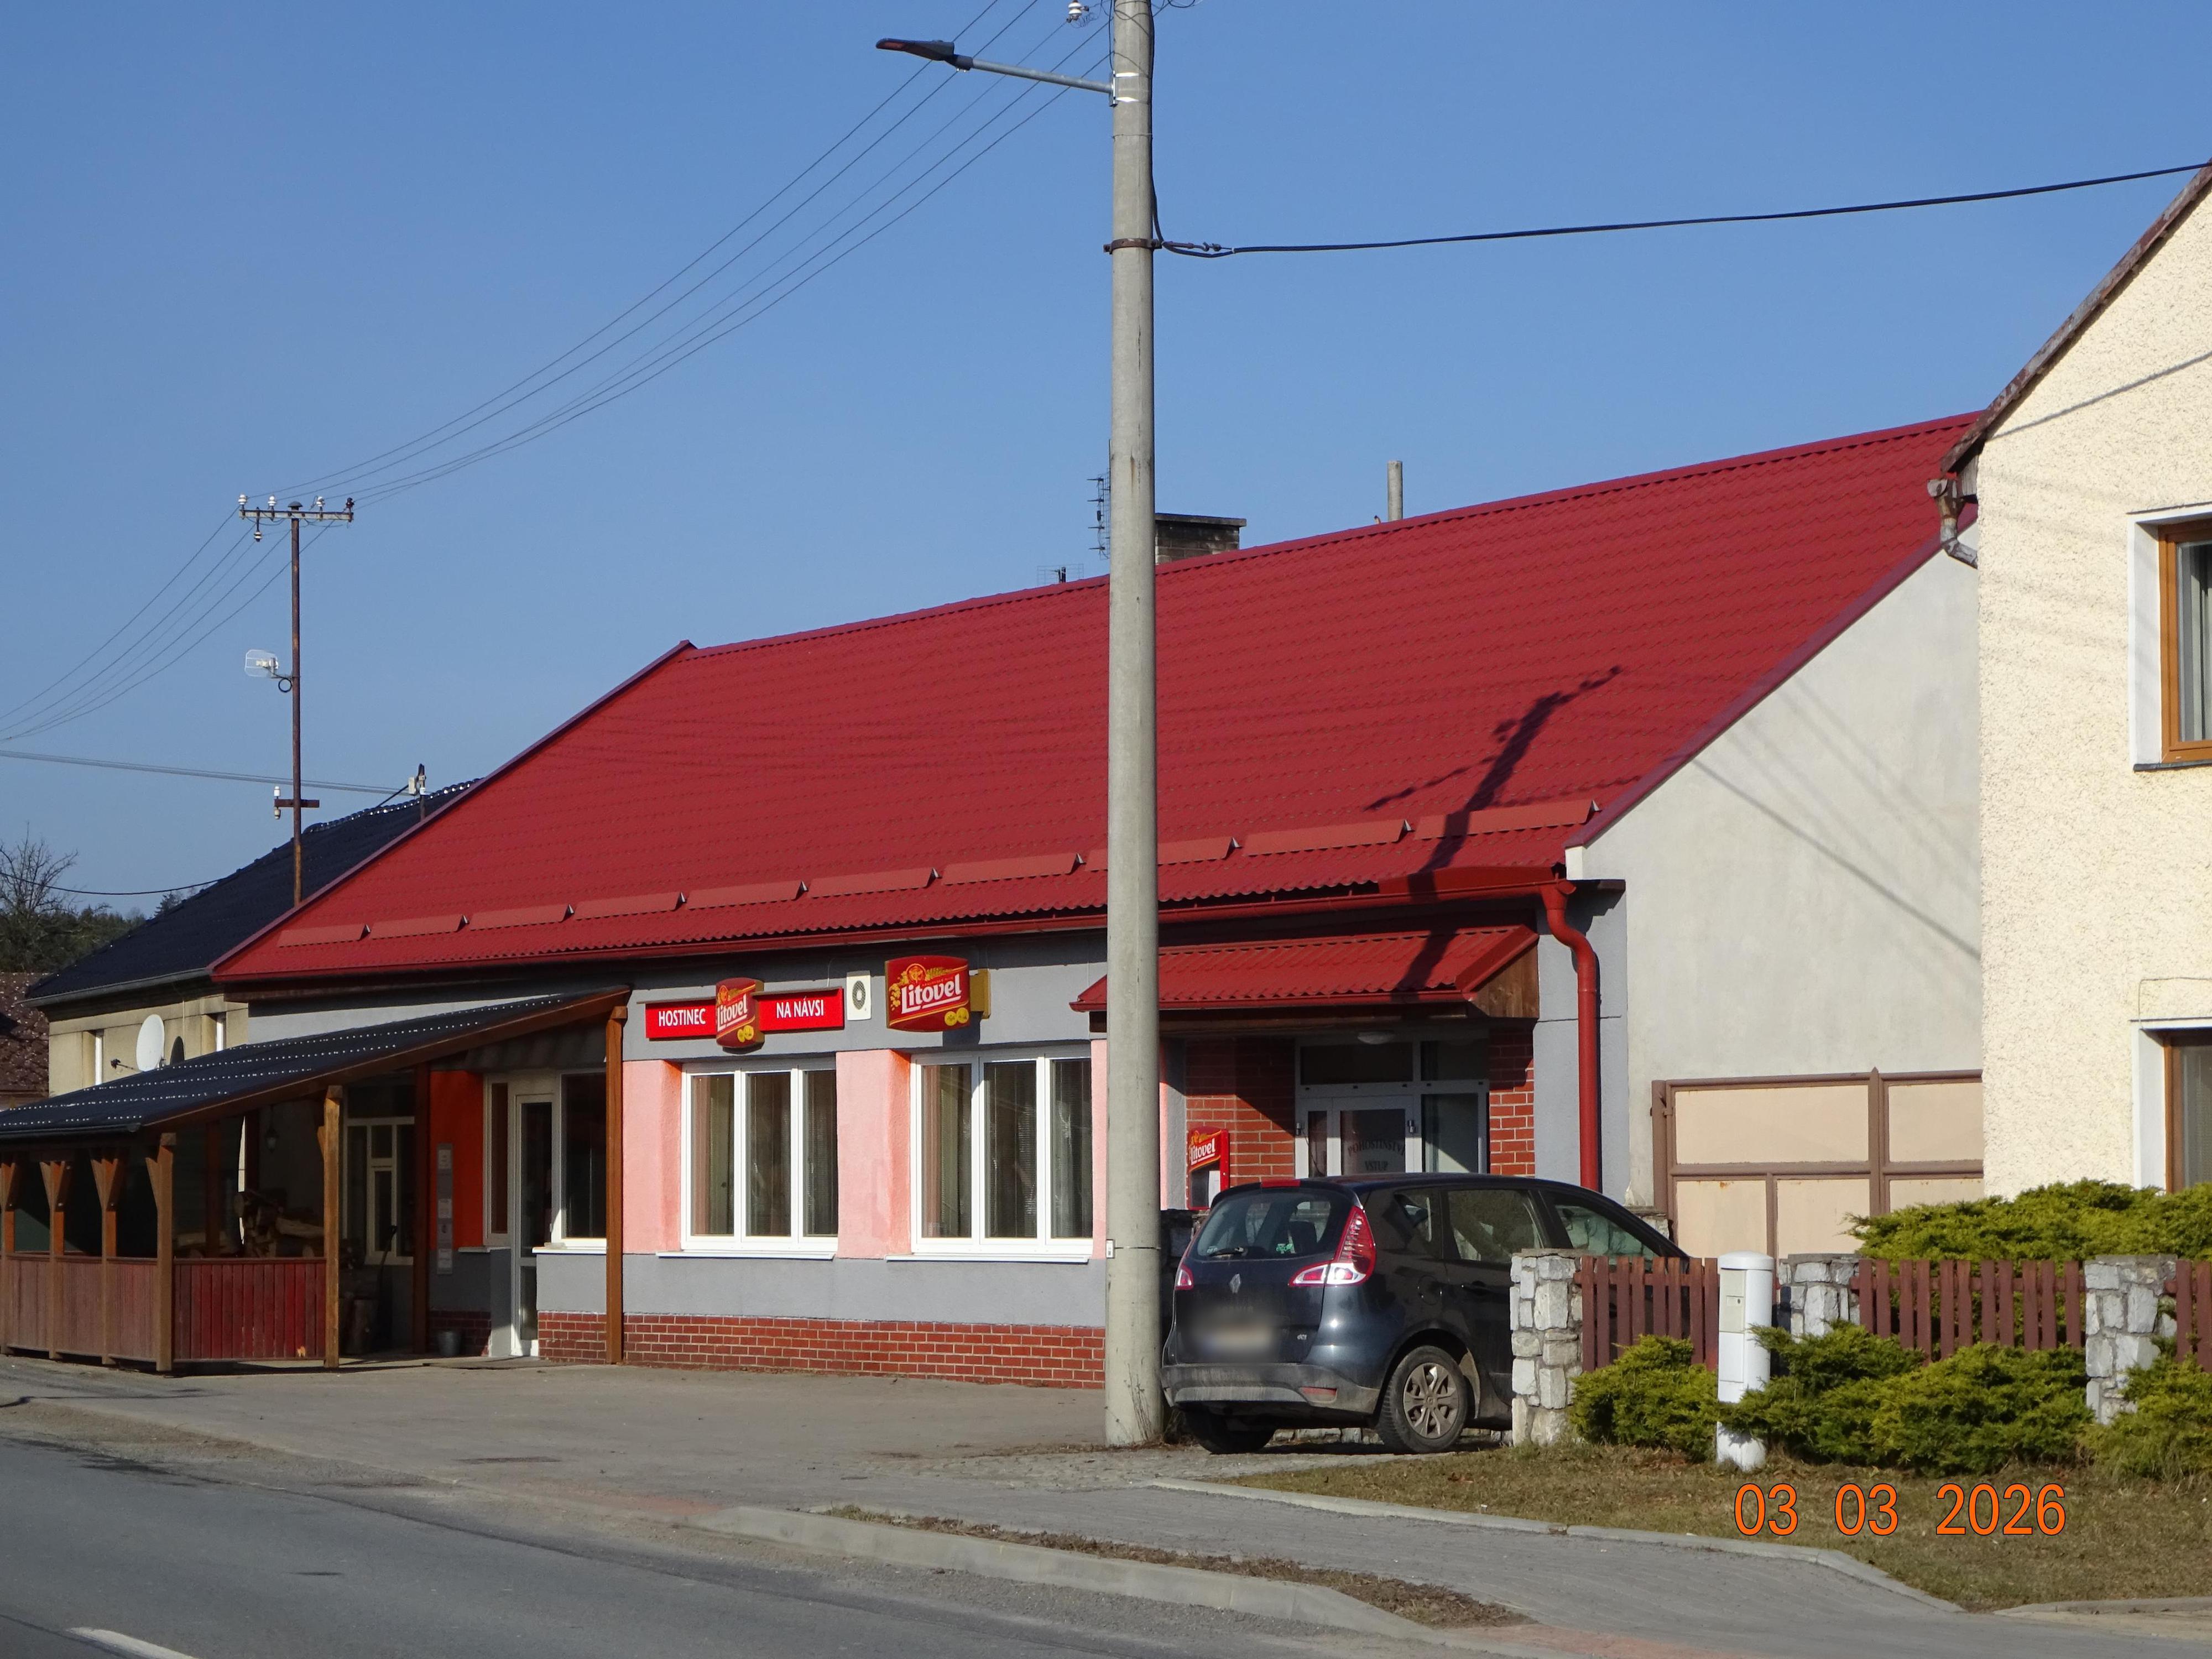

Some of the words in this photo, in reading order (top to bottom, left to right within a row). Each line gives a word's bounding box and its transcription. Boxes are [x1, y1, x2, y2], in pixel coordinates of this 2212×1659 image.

[776, 1001, 791, 1019] NA
[794, 995, 823, 1018] NÁVSI
[901, 973, 962, 1014] Litovel
[659, 1008, 706, 1027] HOSTINEC
[717, 994, 748, 1032] Litovel
[1191, 1138, 1216, 1166] Litovel
